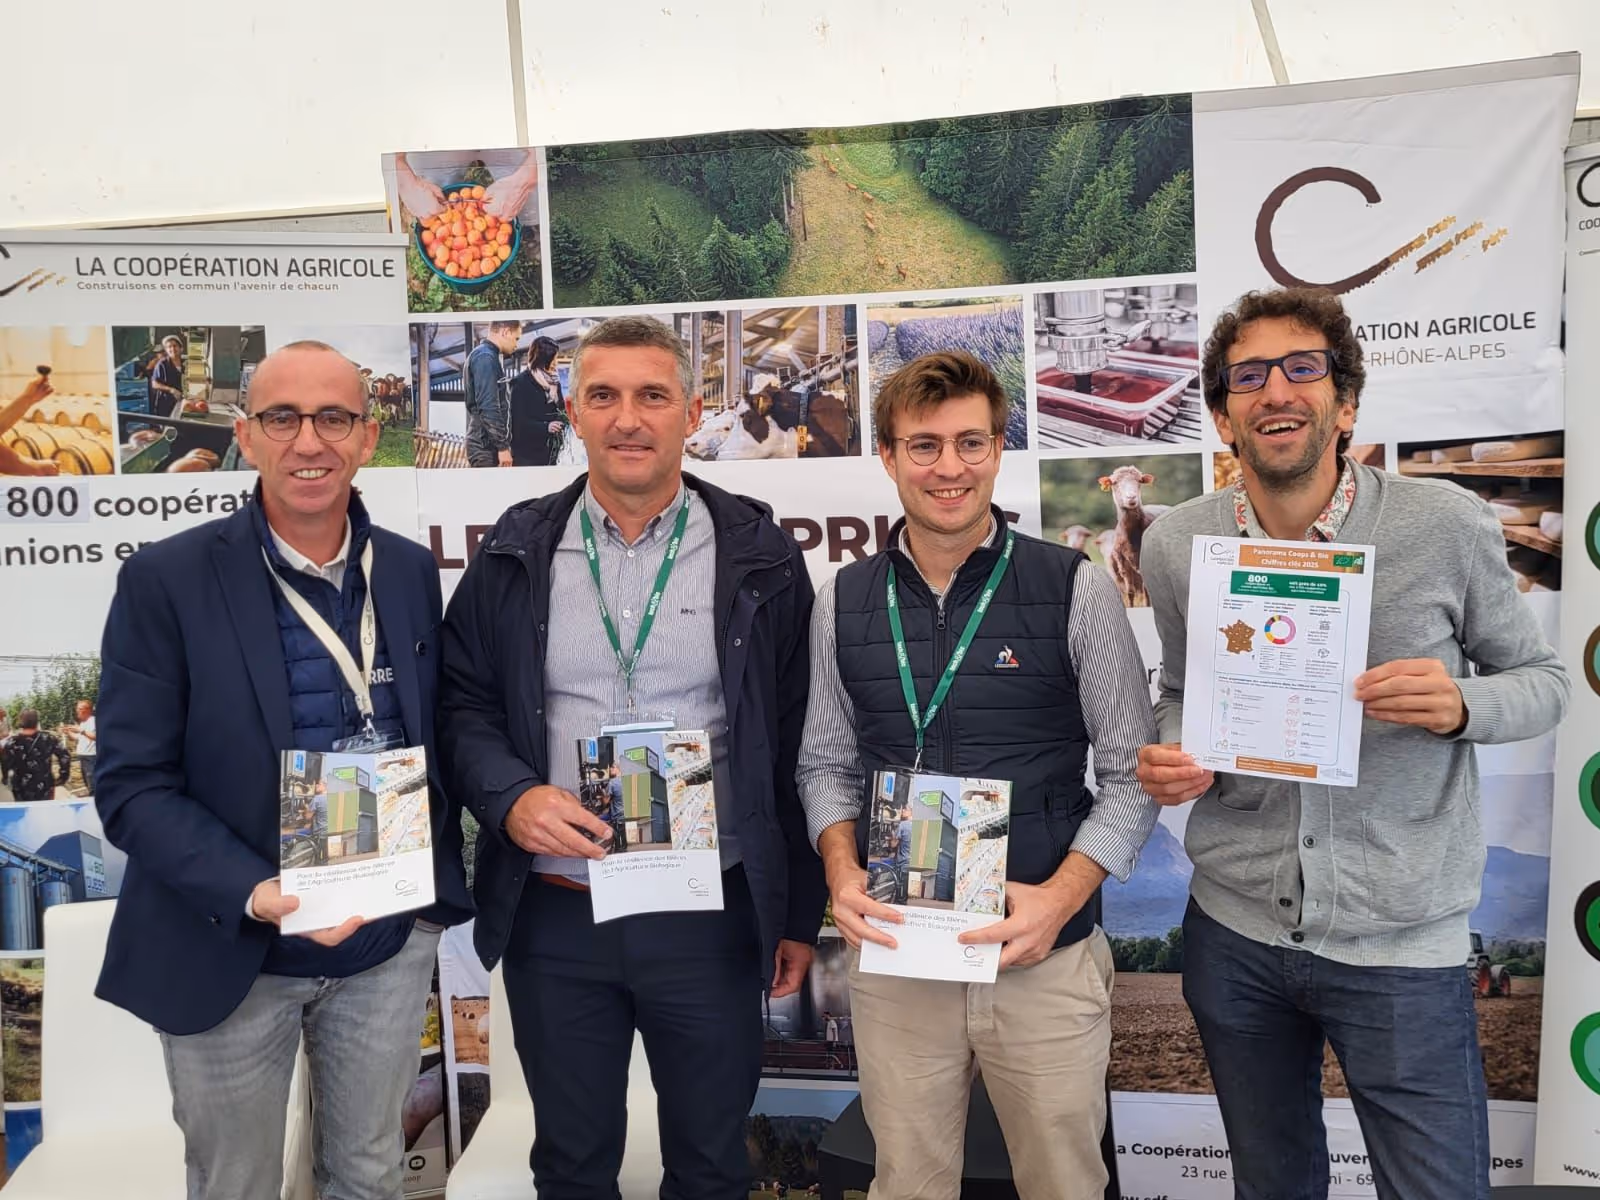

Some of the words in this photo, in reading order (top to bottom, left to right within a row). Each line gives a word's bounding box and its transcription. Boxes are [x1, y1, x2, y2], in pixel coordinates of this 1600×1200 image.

[1579, 217, 1600, 231] COO
[75, 257, 106, 276] LA
[113, 252, 280, 277] COOPÉRATION
[286, 258, 395, 278] AGRICOLE
[77, 281, 157, 290] Construisons
[178, 282, 230, 290] commun
[233, 281, 276, 290] l'avenir
[280, 282, 294, 291] de
[297, 282, 340, 291] chacun
[1355, 320, 1420, 342] ATION
[1427, 311, 1537, 338] AGRICOLE
[1362, 342, 1507, 367] -RHÔNE-ALPES
[6, 486, 80, 518] 800
[93, 487, 255, 522] coopérat
[0, 537, 104, 567] nions
[1247, 574, 1268, 583] 800
[368, 667, 395, 685] RRE
[1181, 1165, 1199, 1179] 23
[1203, 1169, 1228, 1180] rue
[1356, 1173, 1375, 1186] 69
